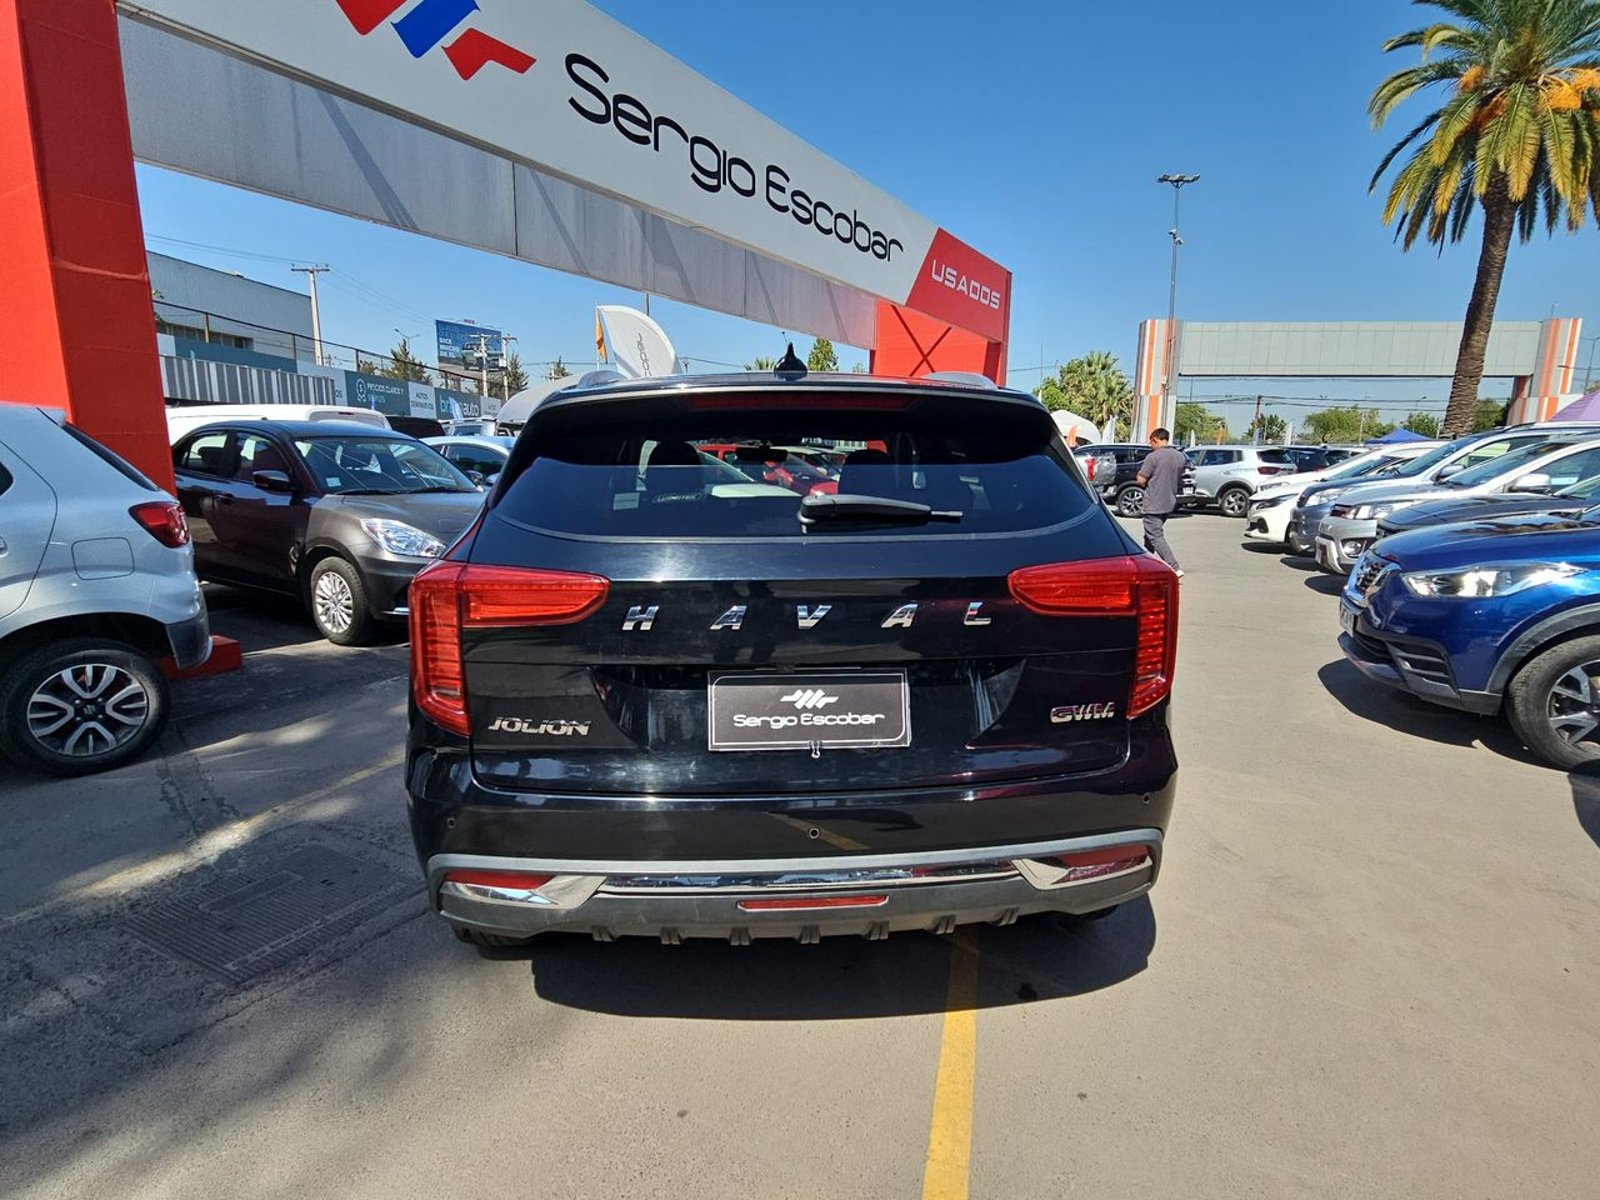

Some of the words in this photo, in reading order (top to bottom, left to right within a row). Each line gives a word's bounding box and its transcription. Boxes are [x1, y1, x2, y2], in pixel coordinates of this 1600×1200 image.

[564, 53, 755, 198] Sergio
[766, 165, 904, 262] Escobar
[931, 259, 1000, 310] USADOS
[621, 601, 992, 631] HAVAL
[733, 714, 798, 729] Sergio
[800, 712, 885, 726] Escobar
[1049, 702, 1115, 723] GWM
[488, 717, 592, 736] JOLION
